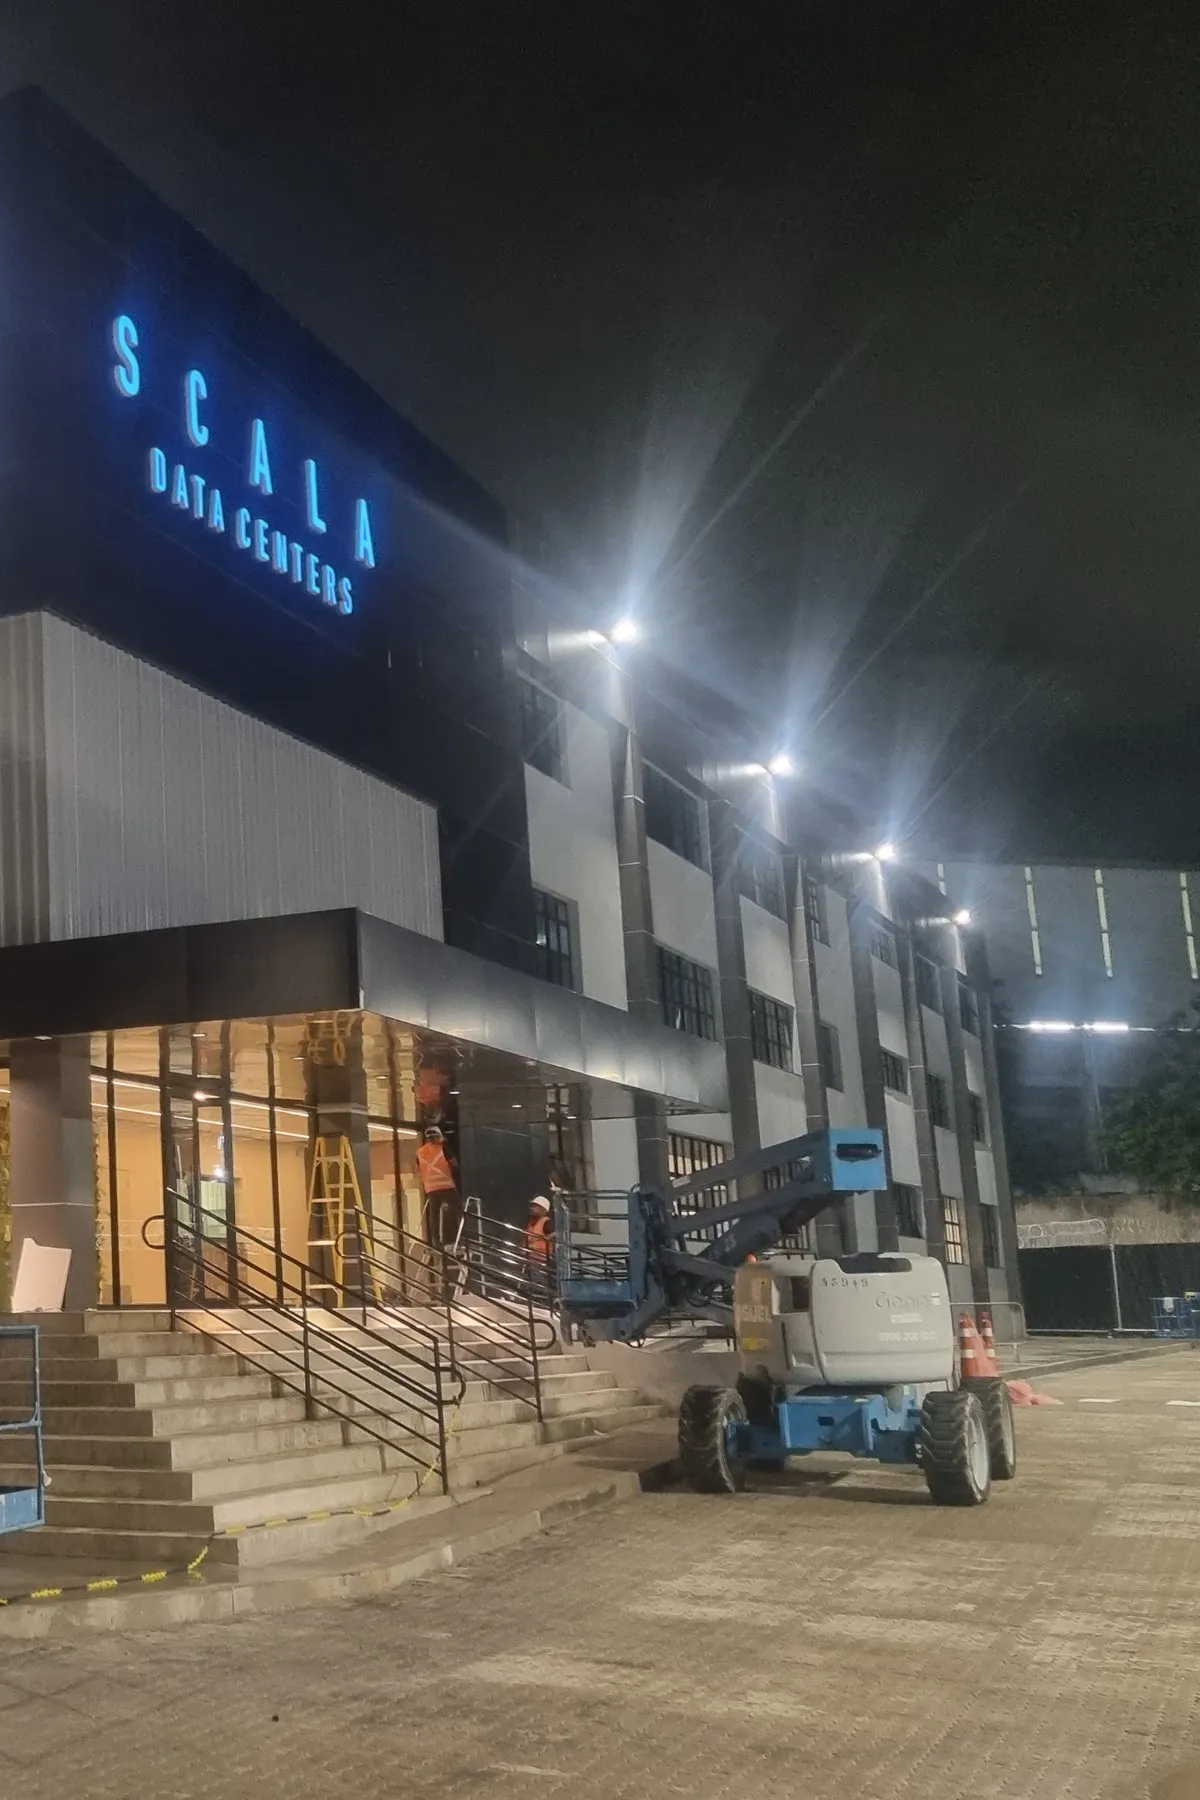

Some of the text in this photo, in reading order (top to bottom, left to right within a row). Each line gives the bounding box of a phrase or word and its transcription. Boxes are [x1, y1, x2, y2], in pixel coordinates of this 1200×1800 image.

[111, 314, 377, 569] SCALA
[148, 446, 354, 616] DATA CENTERS
